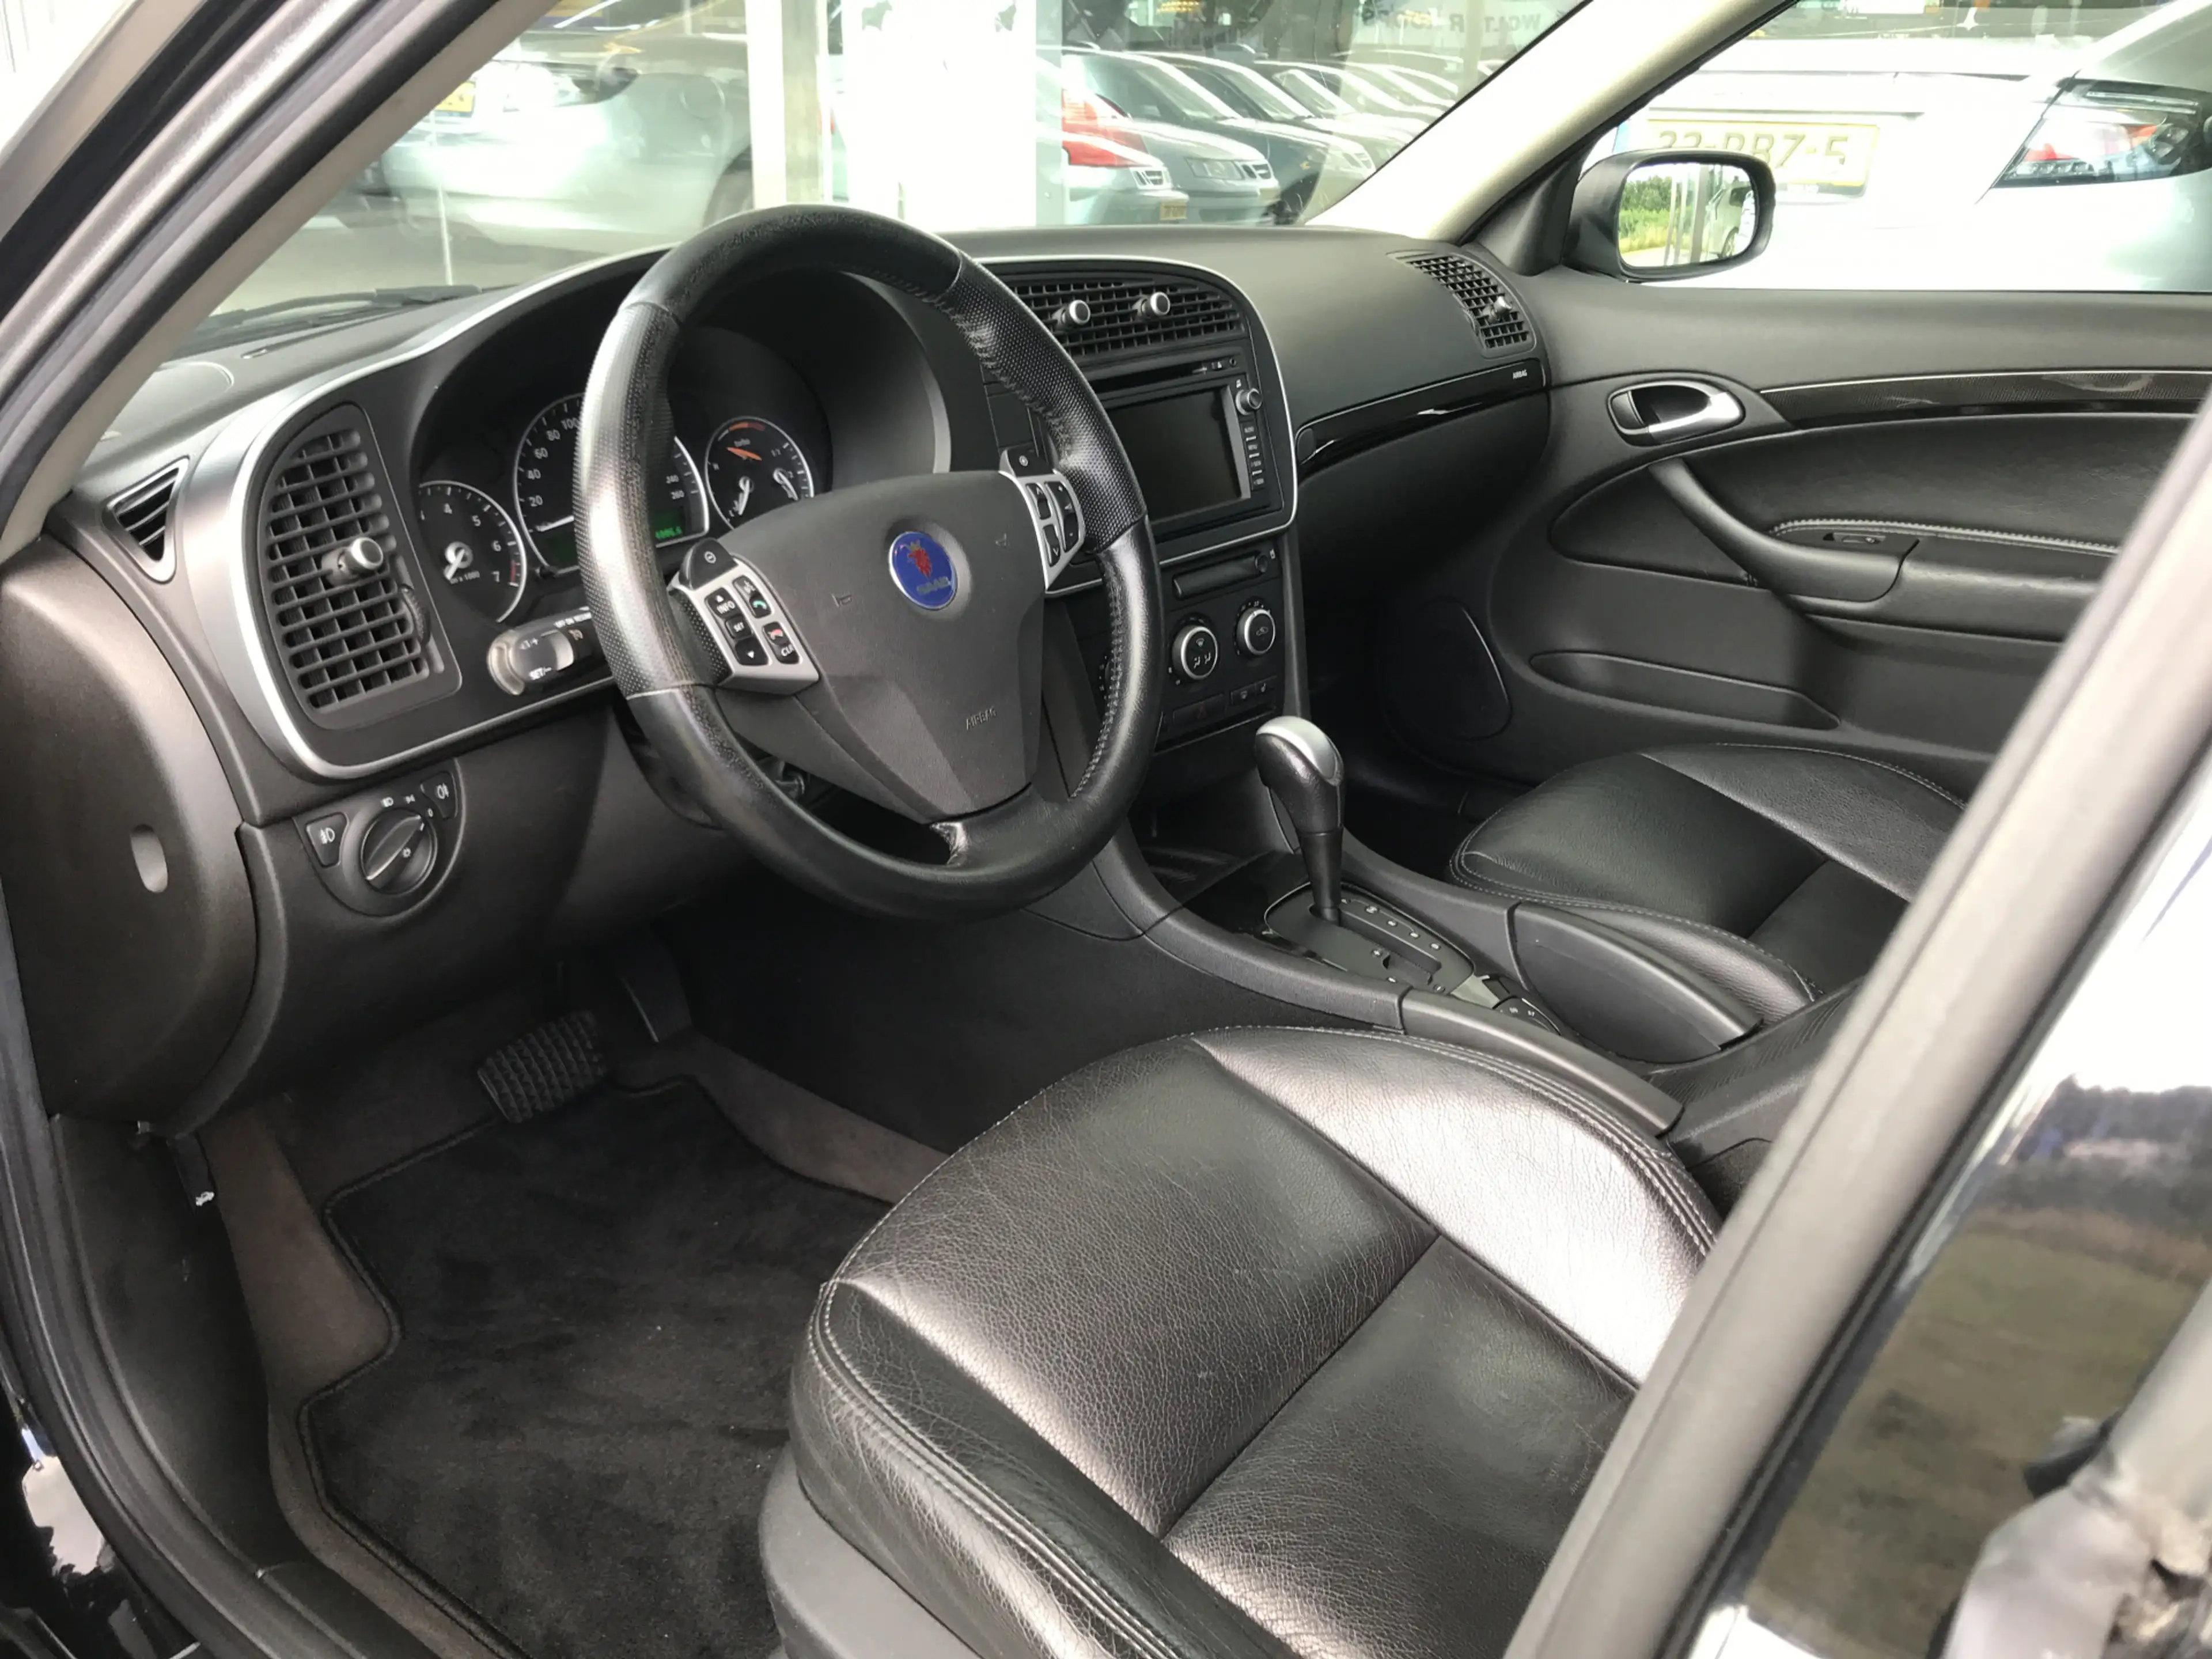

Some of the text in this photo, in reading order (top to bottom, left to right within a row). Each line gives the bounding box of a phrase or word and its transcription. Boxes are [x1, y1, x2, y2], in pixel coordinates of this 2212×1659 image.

[547, 429, 561, 441] 80
[533, 447, 548, 459] 60
[527, 468, 542, 480] 40
[528, 495, 543, 507] 20
[444, 503, 453, 514] 4
[472, 515, 481, 527] 5
[492, 540, 502, 552] 6
[491, 571, 500, 582] 7
[716, 600, 736, 614] INFO
[733, 622, 745, 632] SET
